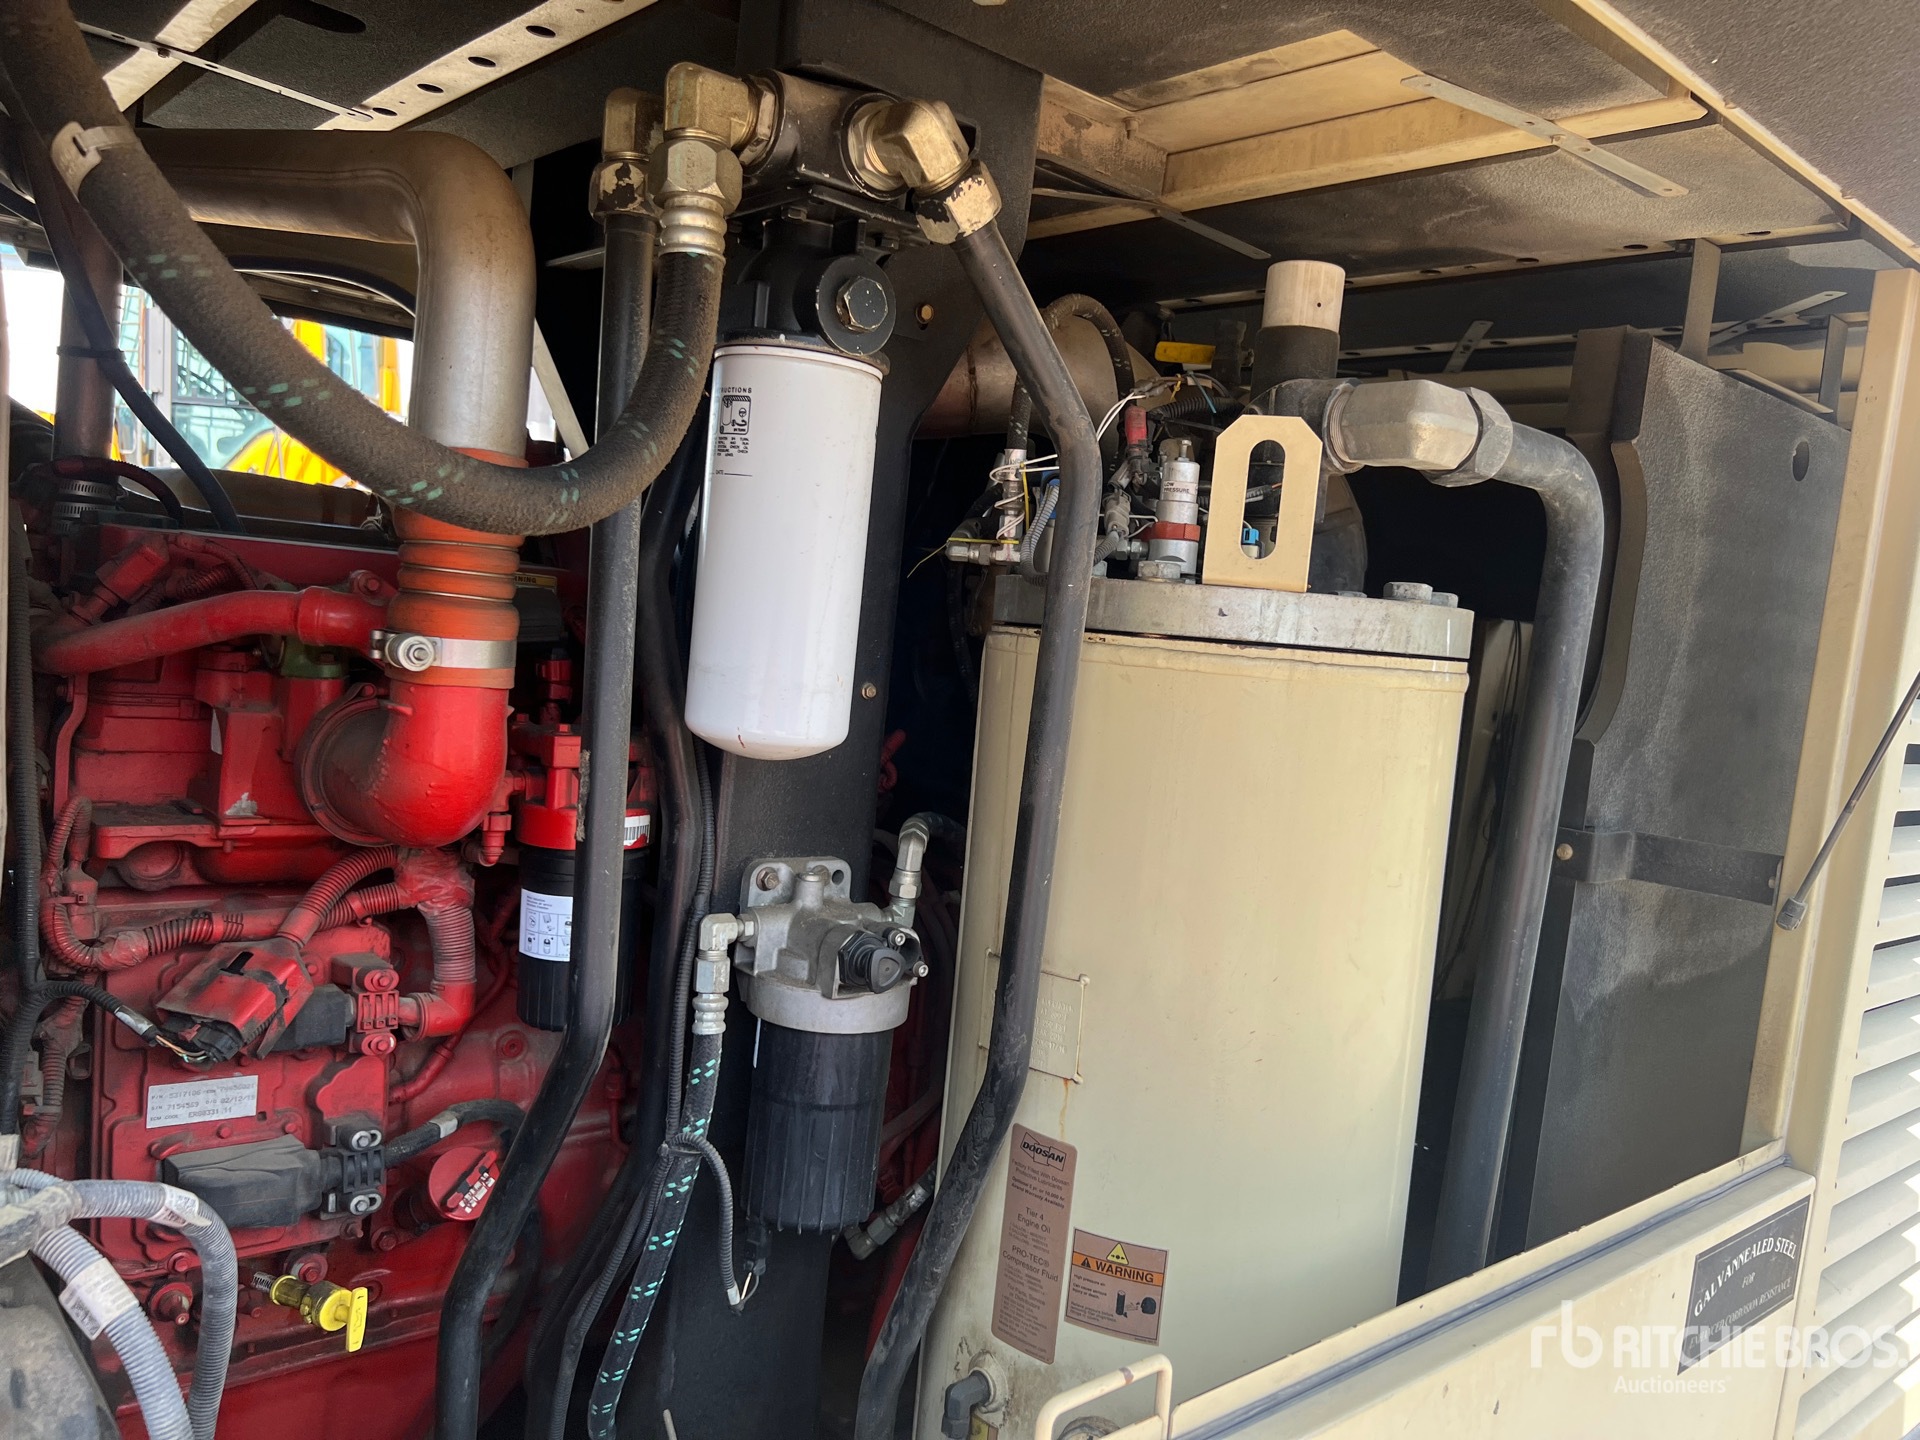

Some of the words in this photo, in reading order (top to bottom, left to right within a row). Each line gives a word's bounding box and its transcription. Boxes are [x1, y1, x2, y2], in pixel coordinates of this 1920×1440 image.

[1022, 1141, 1064, 1163] DOOSAN
[1017, 1213, 1040, 1231] Engine
[1040, 1223, 1051, 1235] Oil
[1025, 1206, 1038, 1218] Tier
[1039, 1213, 1044, 1221] 4
[1002, 1249, 1041, 1275] Compressor
[1041, 1268, 1059, 1282] Fluid
[1095, 1259, 1155, 1284] WARNING
[1693, 1236, 1775, 1317] GALVANNEALED
[1774, 1236, 1797, 1260] STEEL
[1741, 1272, 1756, 1289] FOR
